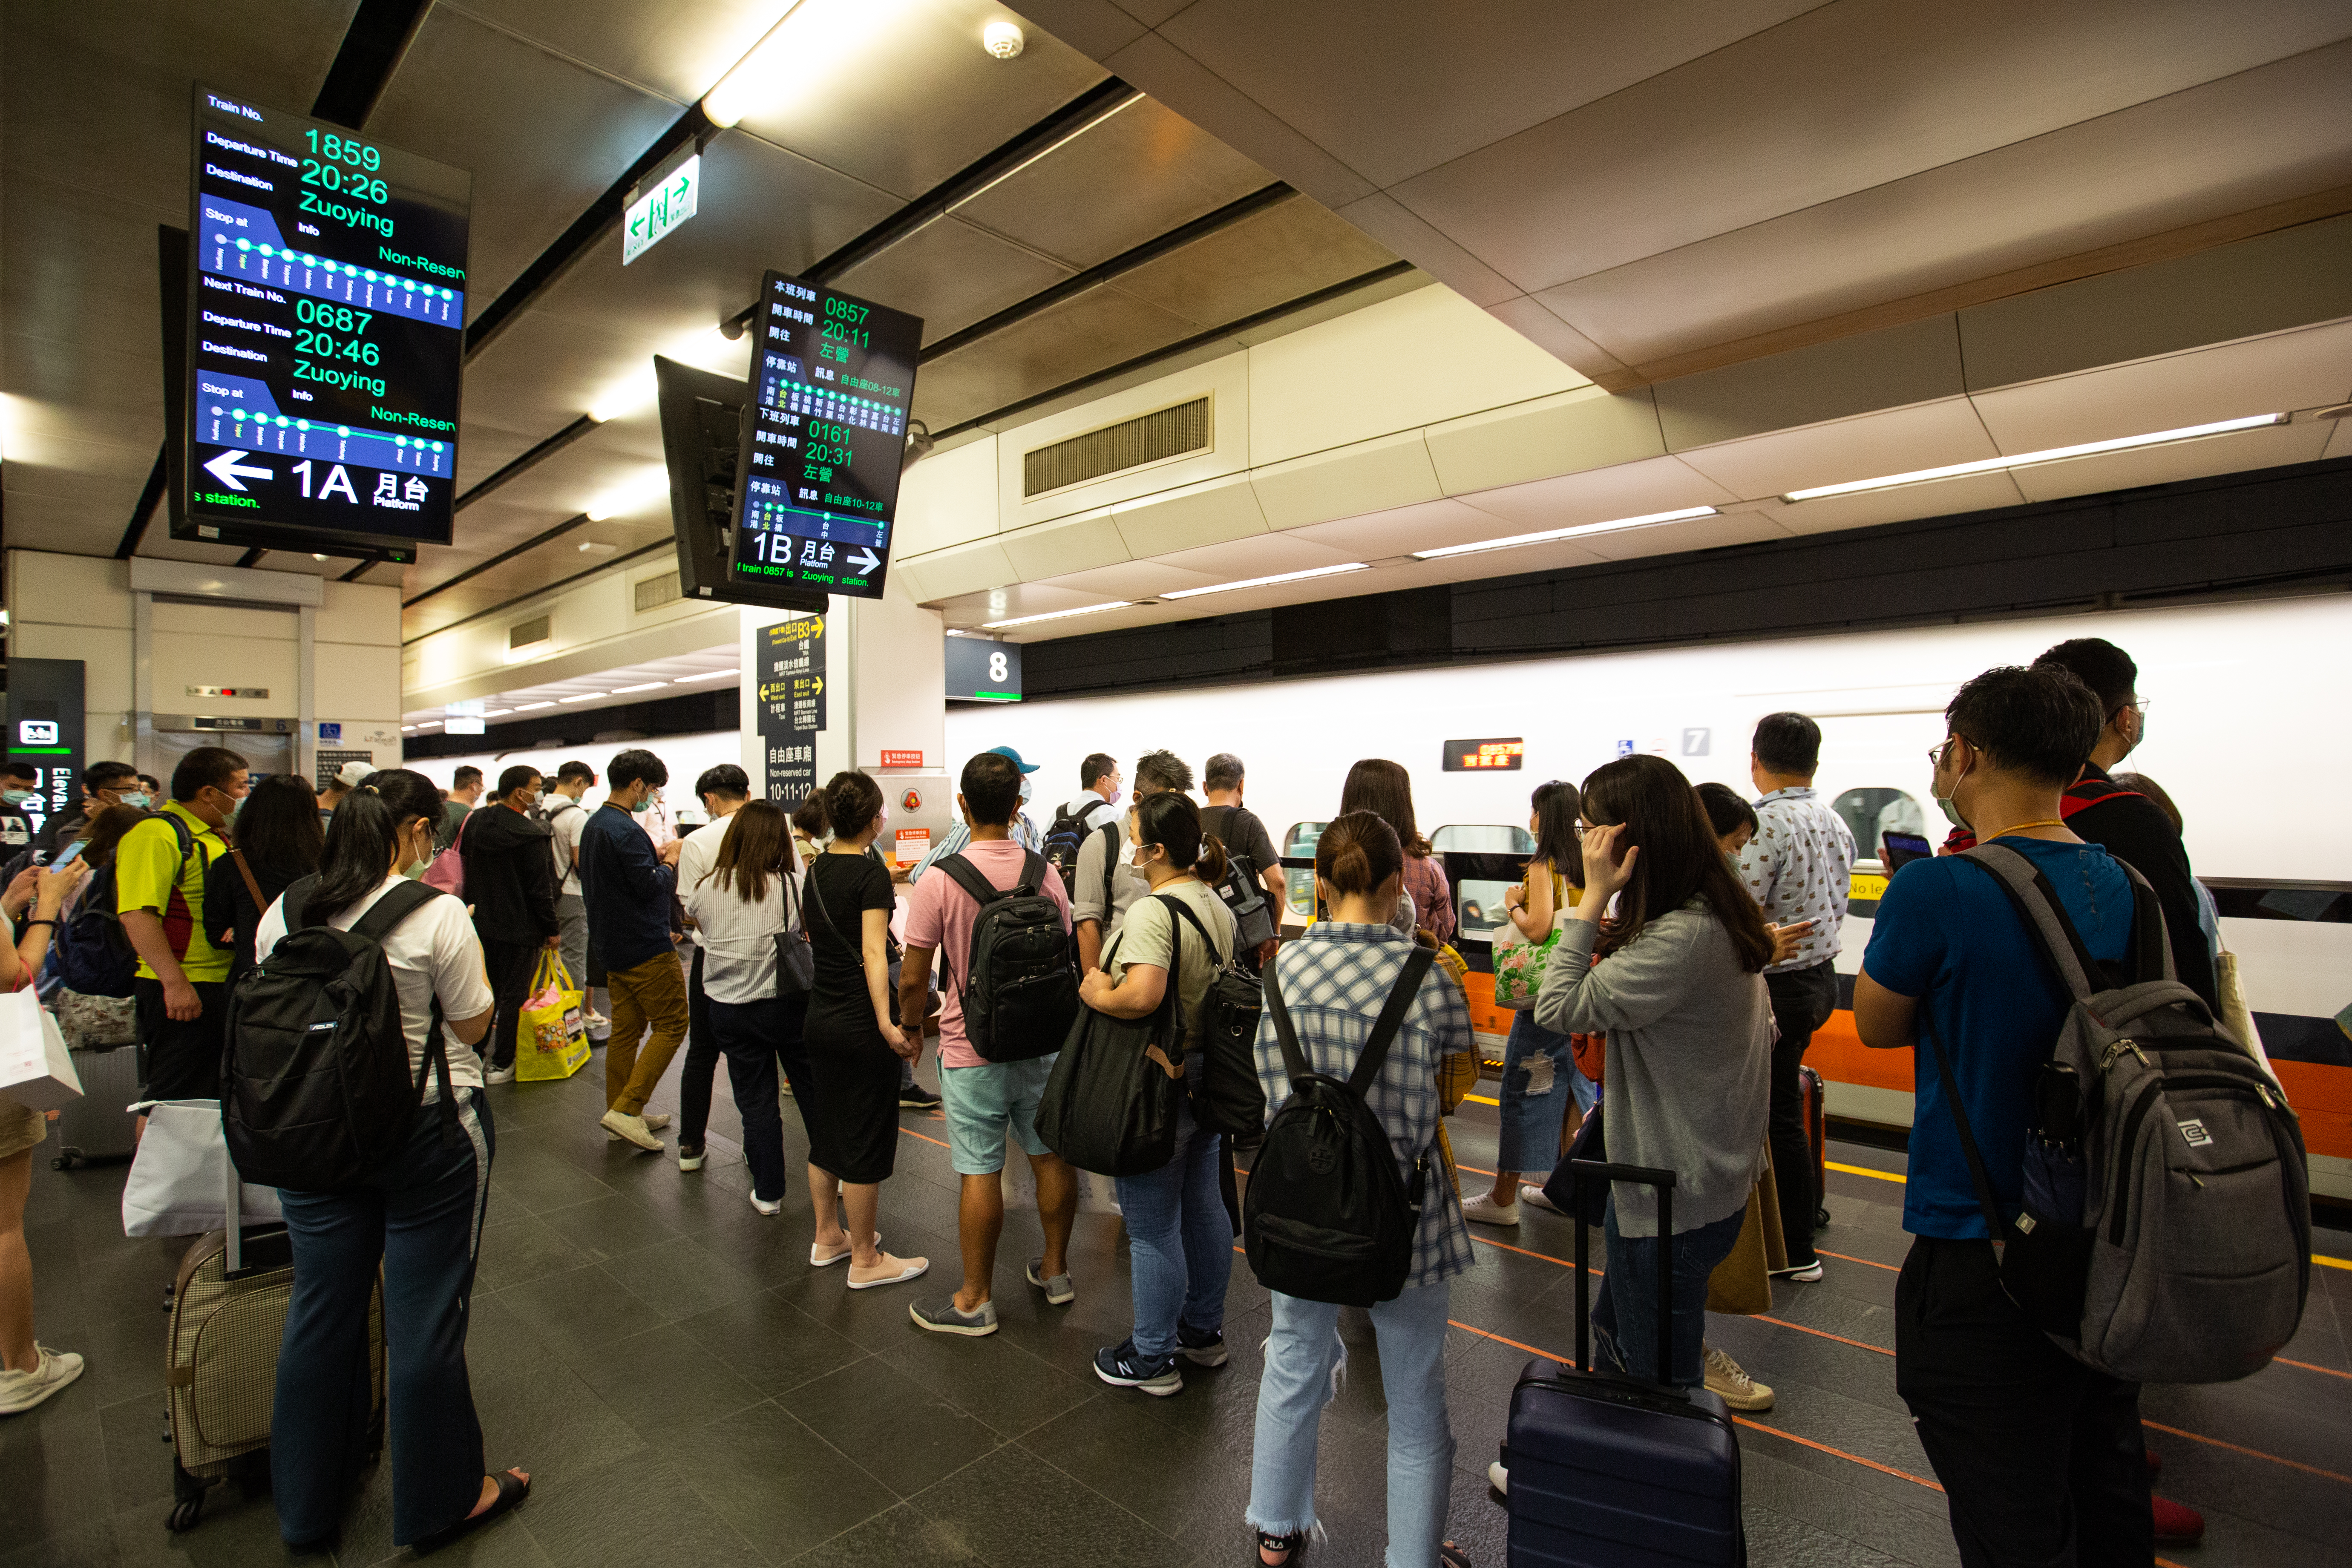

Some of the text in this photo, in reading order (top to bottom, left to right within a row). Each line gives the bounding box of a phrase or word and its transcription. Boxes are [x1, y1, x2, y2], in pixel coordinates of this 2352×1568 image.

[208, 95, 263, 122] Train No.
[207, 131, 298, 168] Departure Time
[305, 129, 380, 171] 1859
[206, 164, 273, 191] Destination
[301, 158, 388, 204] 20:26
[205, 207, 249, 228] Stop at
[299, 190, 394, 237] Zuoying
[298, 222, 320, 236] Info
[204, 276, 286, 304] Next Train No.
[774, 280, 817, 303] 本班列車
[297, 299, 372, 334] 0687
[772, 302, 814, 326] 開車時間
[825, 297, 869, 324] 0857
[203, 311, 292, 338] Departure Time
[769, 325, 791, 342] 開往
[821, 320, 869, 348] 20:11
[202, 341, 268, 363] Destination
[295, 329, 380, 366] 20:46
[820, 342, 849, 364] 左營
[766, 355, 797, 374] 停靠站
[815, 366, 835, 381] 訊息
[293, 359, 385, 397] Zuoying
[841, 374, 900, 398] 自由座08-12車
[202, 383, 244, 399] Stop at
[292, 389, 313, 401] Info
[765, 386, 775, 406] 南港
[777, 389, 787, 409] 台北
[790, 391, 800, 412] 板橋
[802, 394, 812, 415] 桃園
[814, 397, 823, 417] 新竹
[825, 400, 835, 420] 苗栗
[759, 407, 800, 427] 下班列車
[837, 403, 846, 422] 台中
[848, 406, 858, 425] 彰化
[859, 409, 869, 428] 雲林
[870, 411, 880, 431] 嘉義
[809, 420, 851, 446] 0161
[881, 414, 890, 433] 台南
[891, 417, 901, 435] 左營
[756, 430, 798, 449] 開車時間
[753, 452, 774, 467] 開往
[805, 442, 853, 467] 20:31
[293, 460, 358, 503] 1A
[803, 463, 833, 483] 左營
[374, 473, 429, 502] 月台
[750, 480, 781, 496] 停靠站
[799, 487, 818, 501] 訊息
[205, 492, 261, 509] station.
[374, 496, 420, 511] Platform
[824, 492, 884, 512] 自由座10-12車
[750, 509, 760, 529] 南港
[762, 512, 772, 531] 台北
[774, 513, 784, 532] 板橋
[820, 521, 830, 539] 台中
[875, 530, 884, 547] 左營
[753, 531, 792, 564] 1B
[800, 539, 836, 562] 月台
[800, 558, 828, 569] Platform
[742, 563, 762, 574] train
[763, 566, 785, 576] 0857
[786, 569, 794, 578] is
[801, 570, 834, 584] Zuoying
[841, 576, 869, 587] station.
[786, 622, 797, 635] 出口
[797, 621, 810, 639] B3
[989, 652, 1008, 682] 8
[770, 682, 785, 693] 西出口
[794, 679, 810, 689] 東出口
[770, 703, 786, 714] 計程車
[1687, 730, 1707, 753] 7
[770, 745, 812, 764] 自由座車廂
[770, 768, 802, 777] Non-reserved
[1264, 1539, 1284, 1549] FILA
